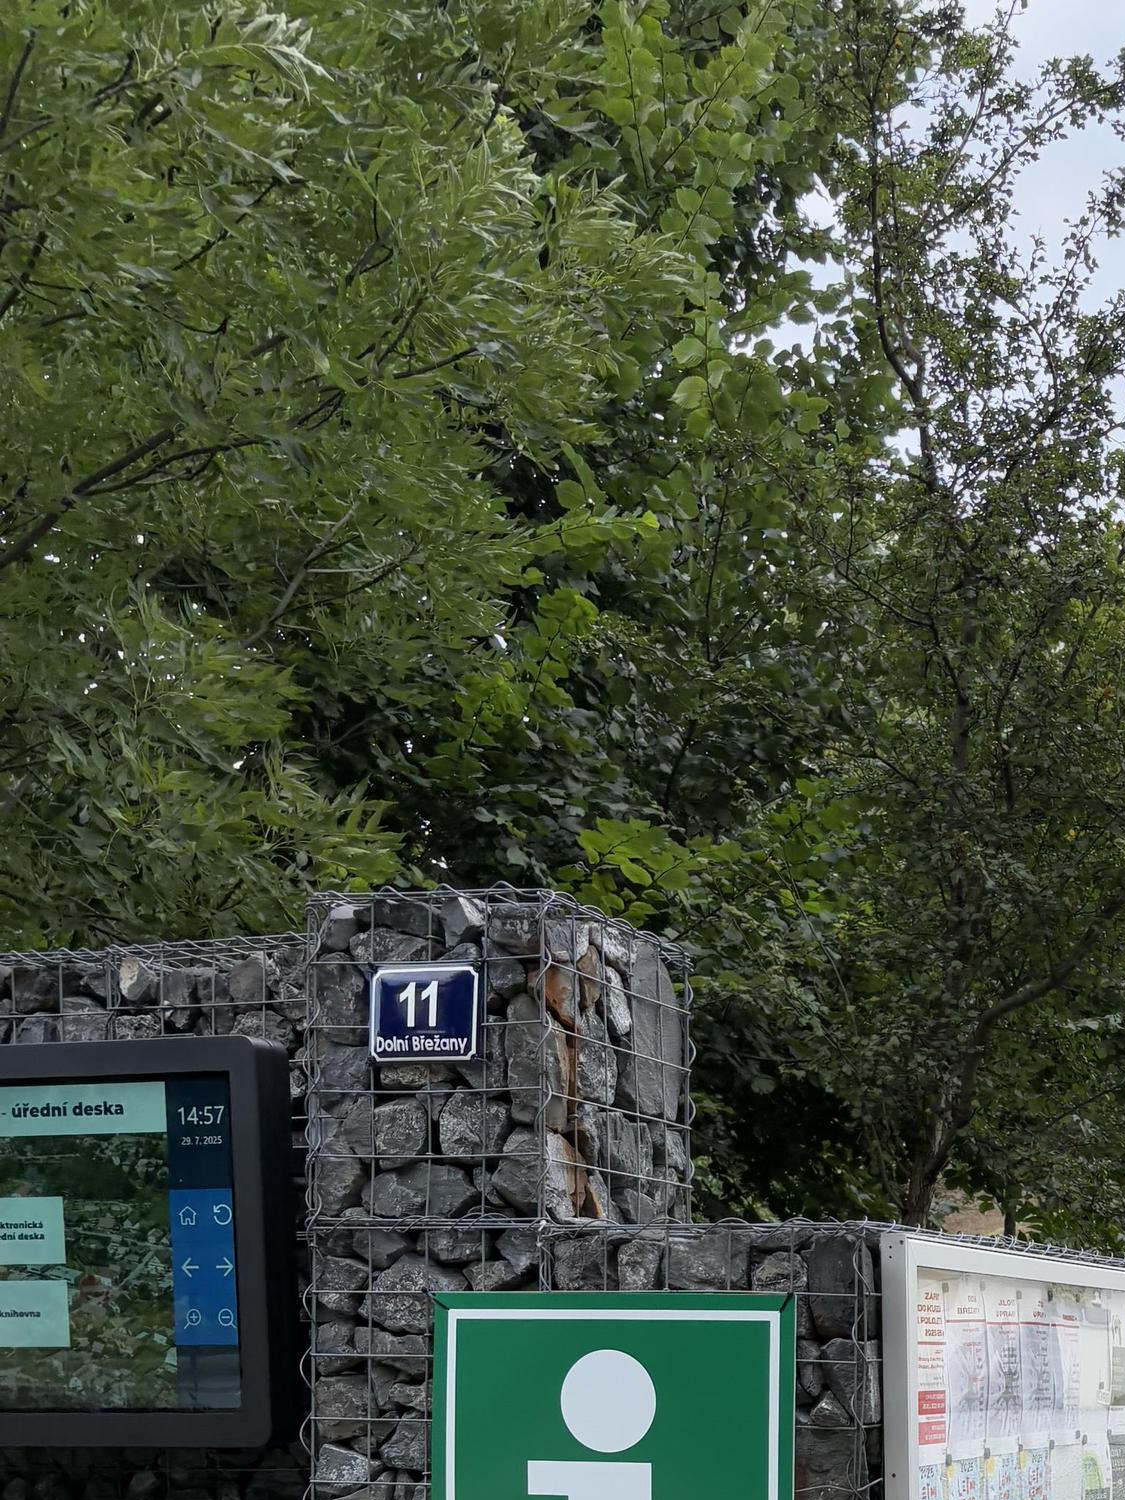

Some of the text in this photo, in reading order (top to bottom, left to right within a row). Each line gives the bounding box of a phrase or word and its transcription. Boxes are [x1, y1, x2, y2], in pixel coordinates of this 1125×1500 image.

[399, 980, 439, 1028] 11
[376, 1034, 468, 1055] Dolní Břežany
[11, 1101, 68, 1119] úřední
[72, 1100, 125, 1117] deska
[177, 1105, 225, 1126] 14:57
[203, 1135, 223, 1146] 2025
[17, 1232, 46, 1241] deska
